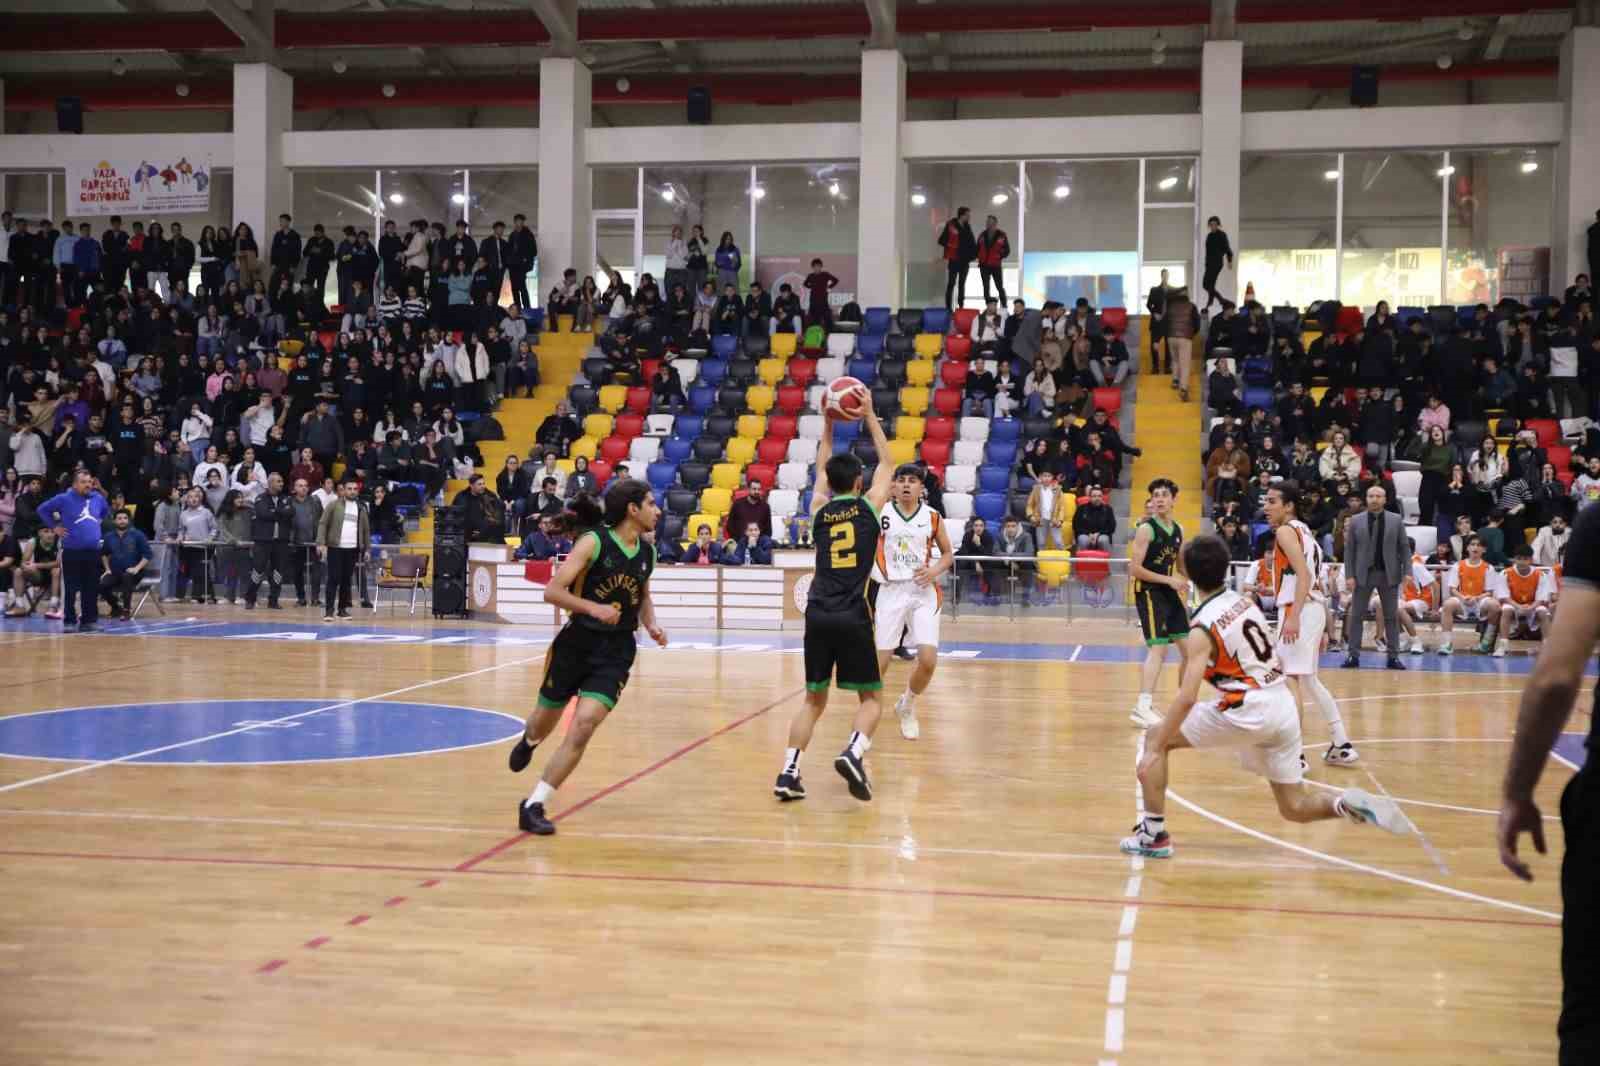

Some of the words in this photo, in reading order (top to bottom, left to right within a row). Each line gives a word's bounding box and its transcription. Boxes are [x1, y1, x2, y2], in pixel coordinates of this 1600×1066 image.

[830, 521, 857, 569] 2
[881, 515, 890, 530] 6
[1242, 618, 1273, 663] 0
